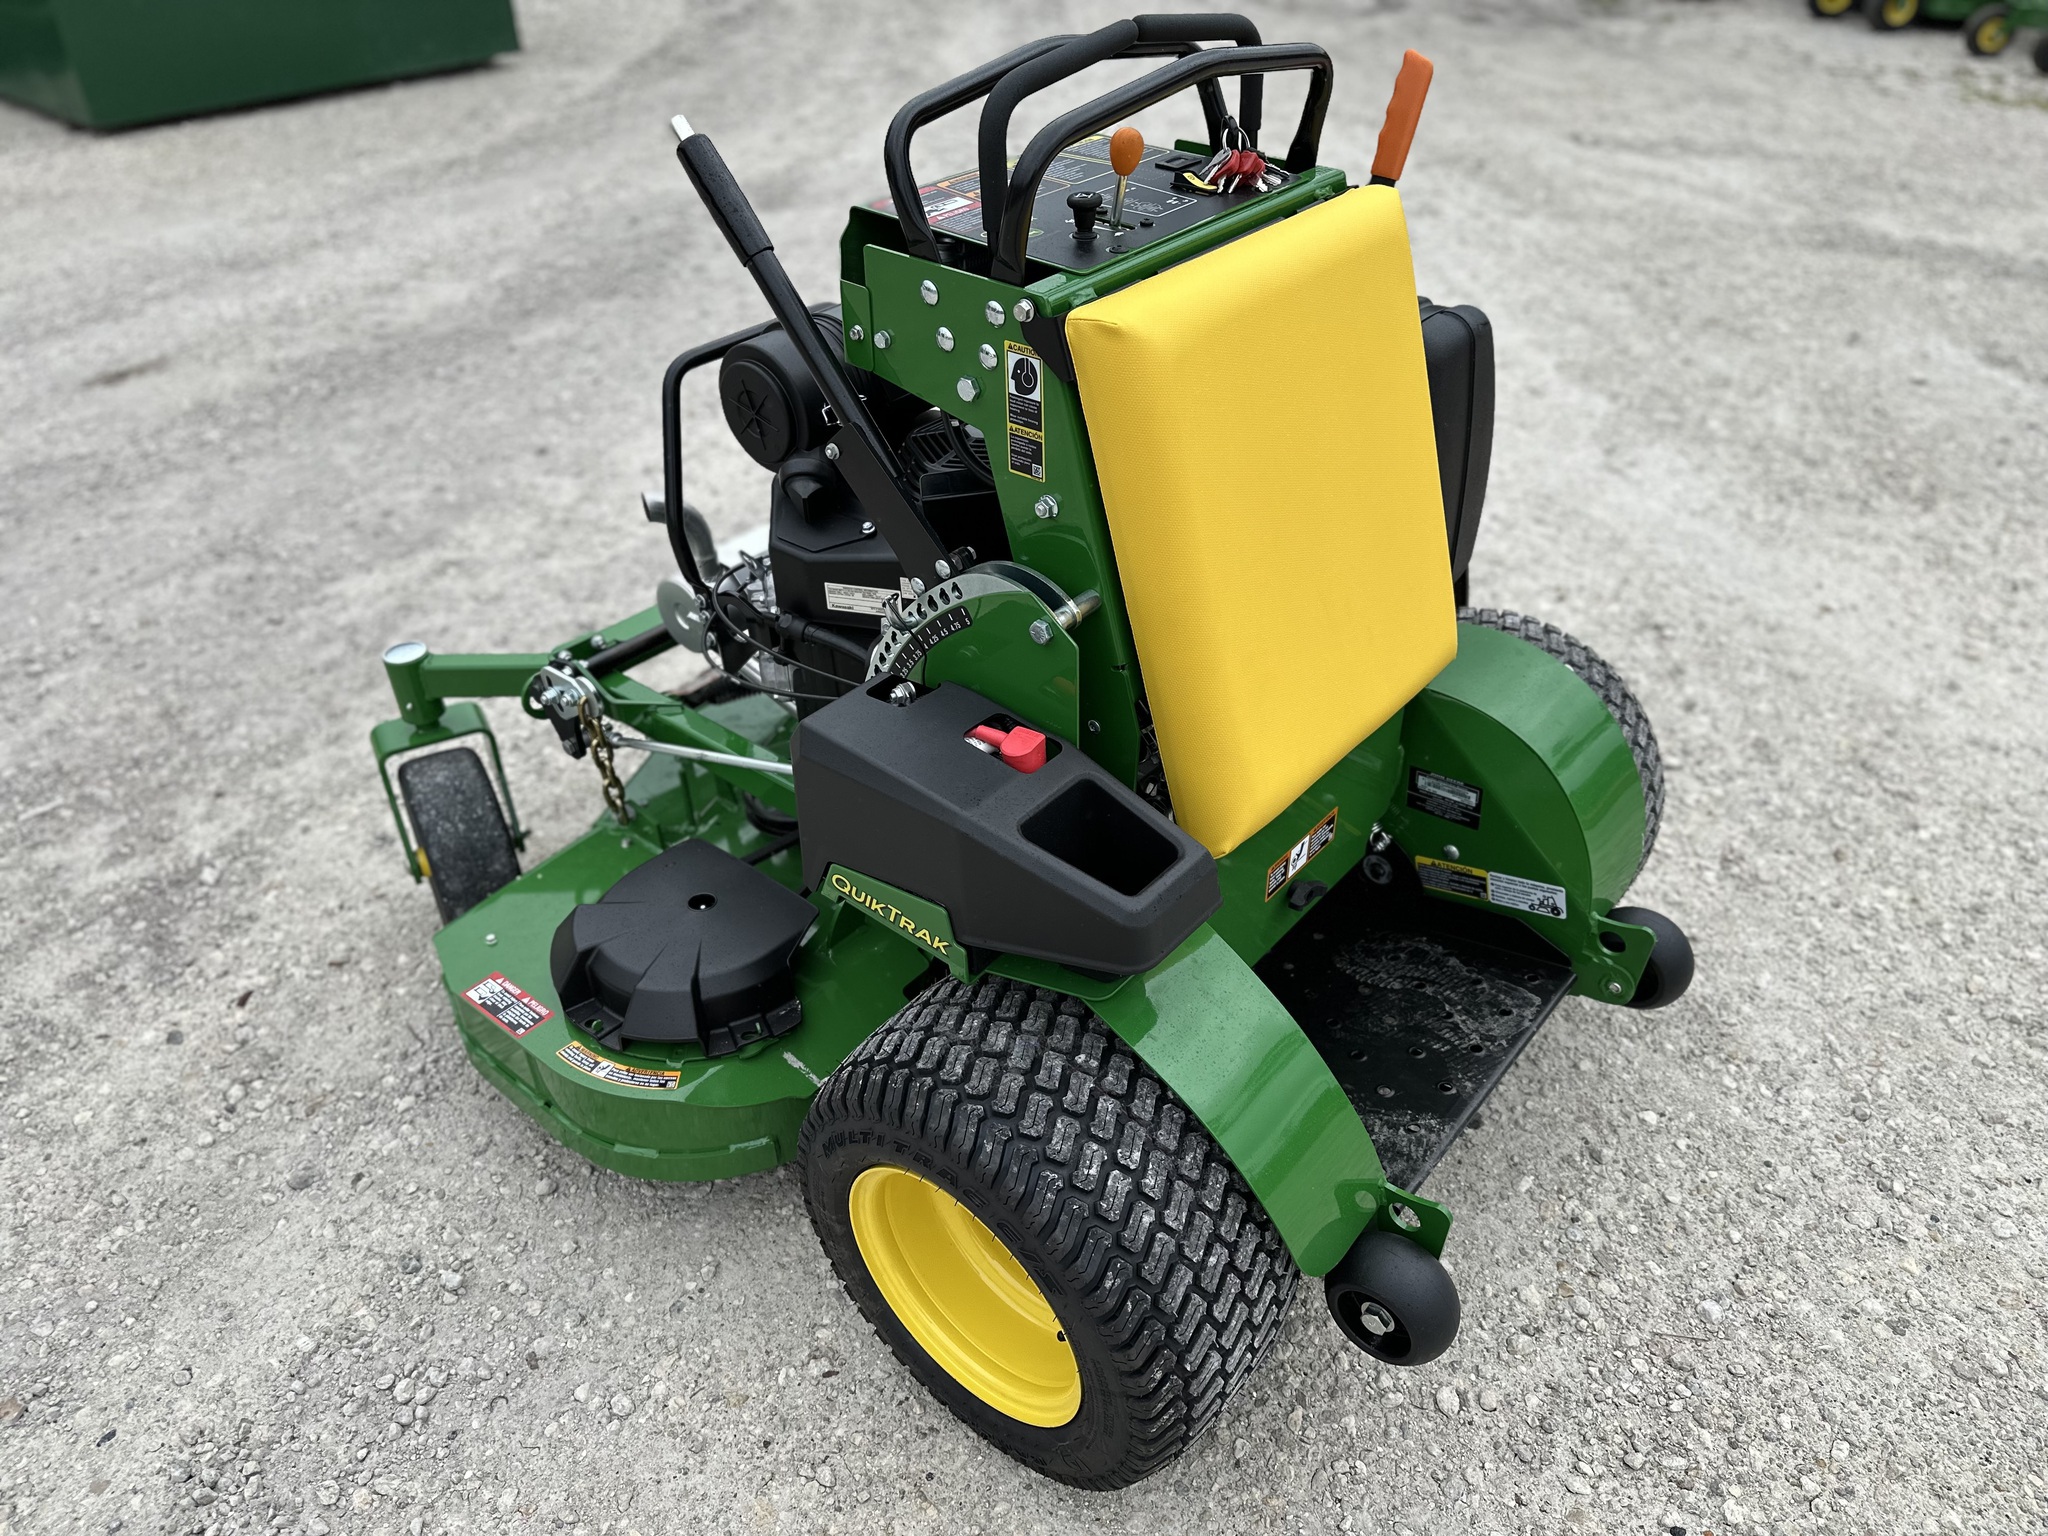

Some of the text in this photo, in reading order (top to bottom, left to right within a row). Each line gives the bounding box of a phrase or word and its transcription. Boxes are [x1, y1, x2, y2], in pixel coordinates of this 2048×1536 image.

[928, 634, 940, 645] 4.25
[940, 628, 949, 637] 4.5
[950, 621, 962, 631] 4.75
[501, 980, 522, 996] DANGER
